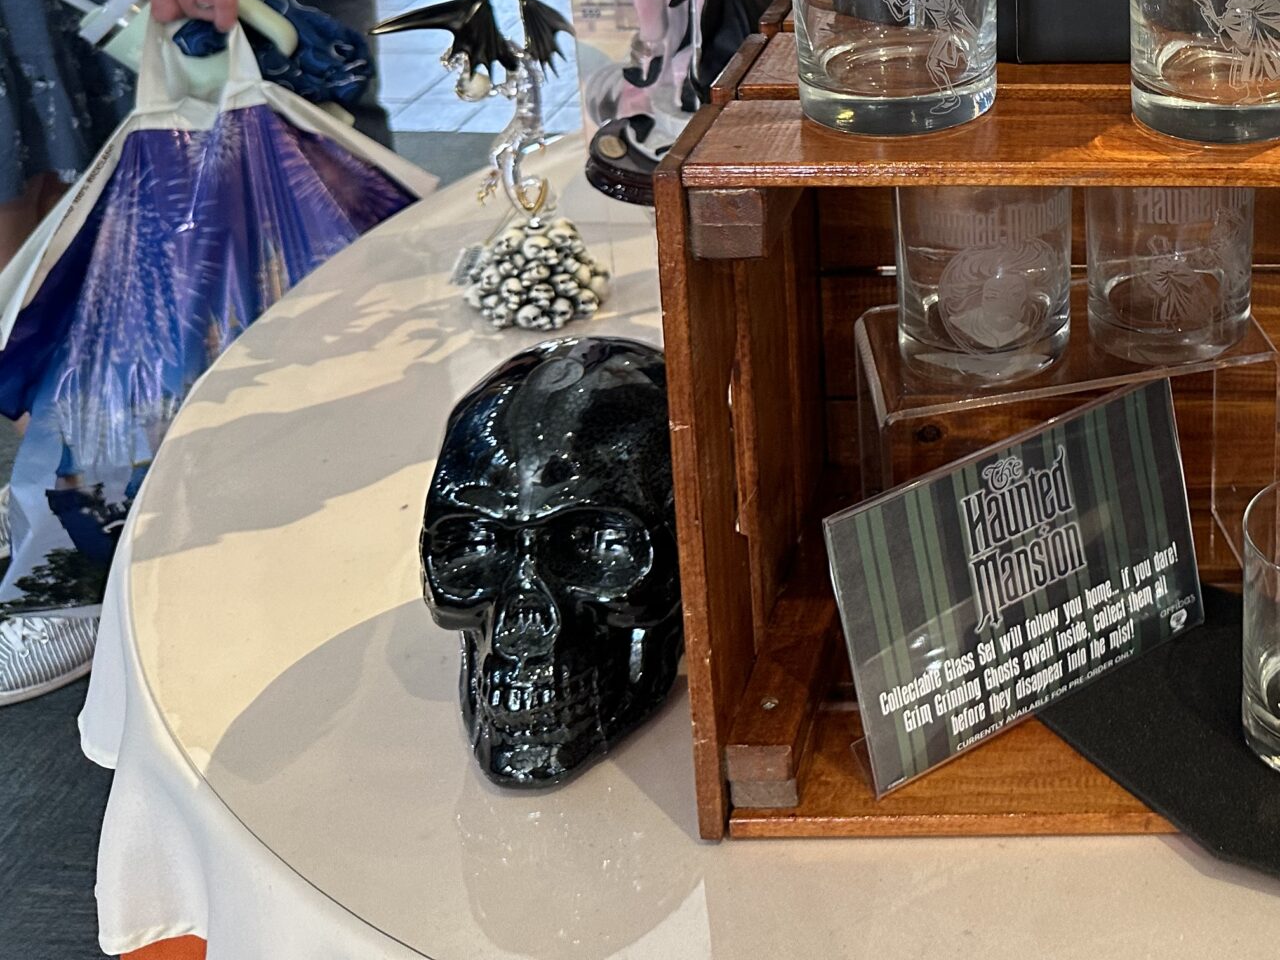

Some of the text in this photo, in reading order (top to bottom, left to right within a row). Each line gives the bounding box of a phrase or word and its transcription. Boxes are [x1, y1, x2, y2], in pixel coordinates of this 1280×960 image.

[960, 444, 1075, 559] Haunted
[982, 455, 1023, 492] The
[879, 541, 1178, 716] Collectable Glass Set will follow you home... if you dare!
[969, 522, 1087, 634] Mansion
[1159, 593, 1196, 619] arribas
[903, 575, 1168, 733] Grim Grinning Ghosts await inside, collect them all
[951, 619, 1135, 735] before they disappear into the mist!
[956, 647, 1135, 751] CURRENTLY AVAILABLE FOR PRE-ORDER ONLY
